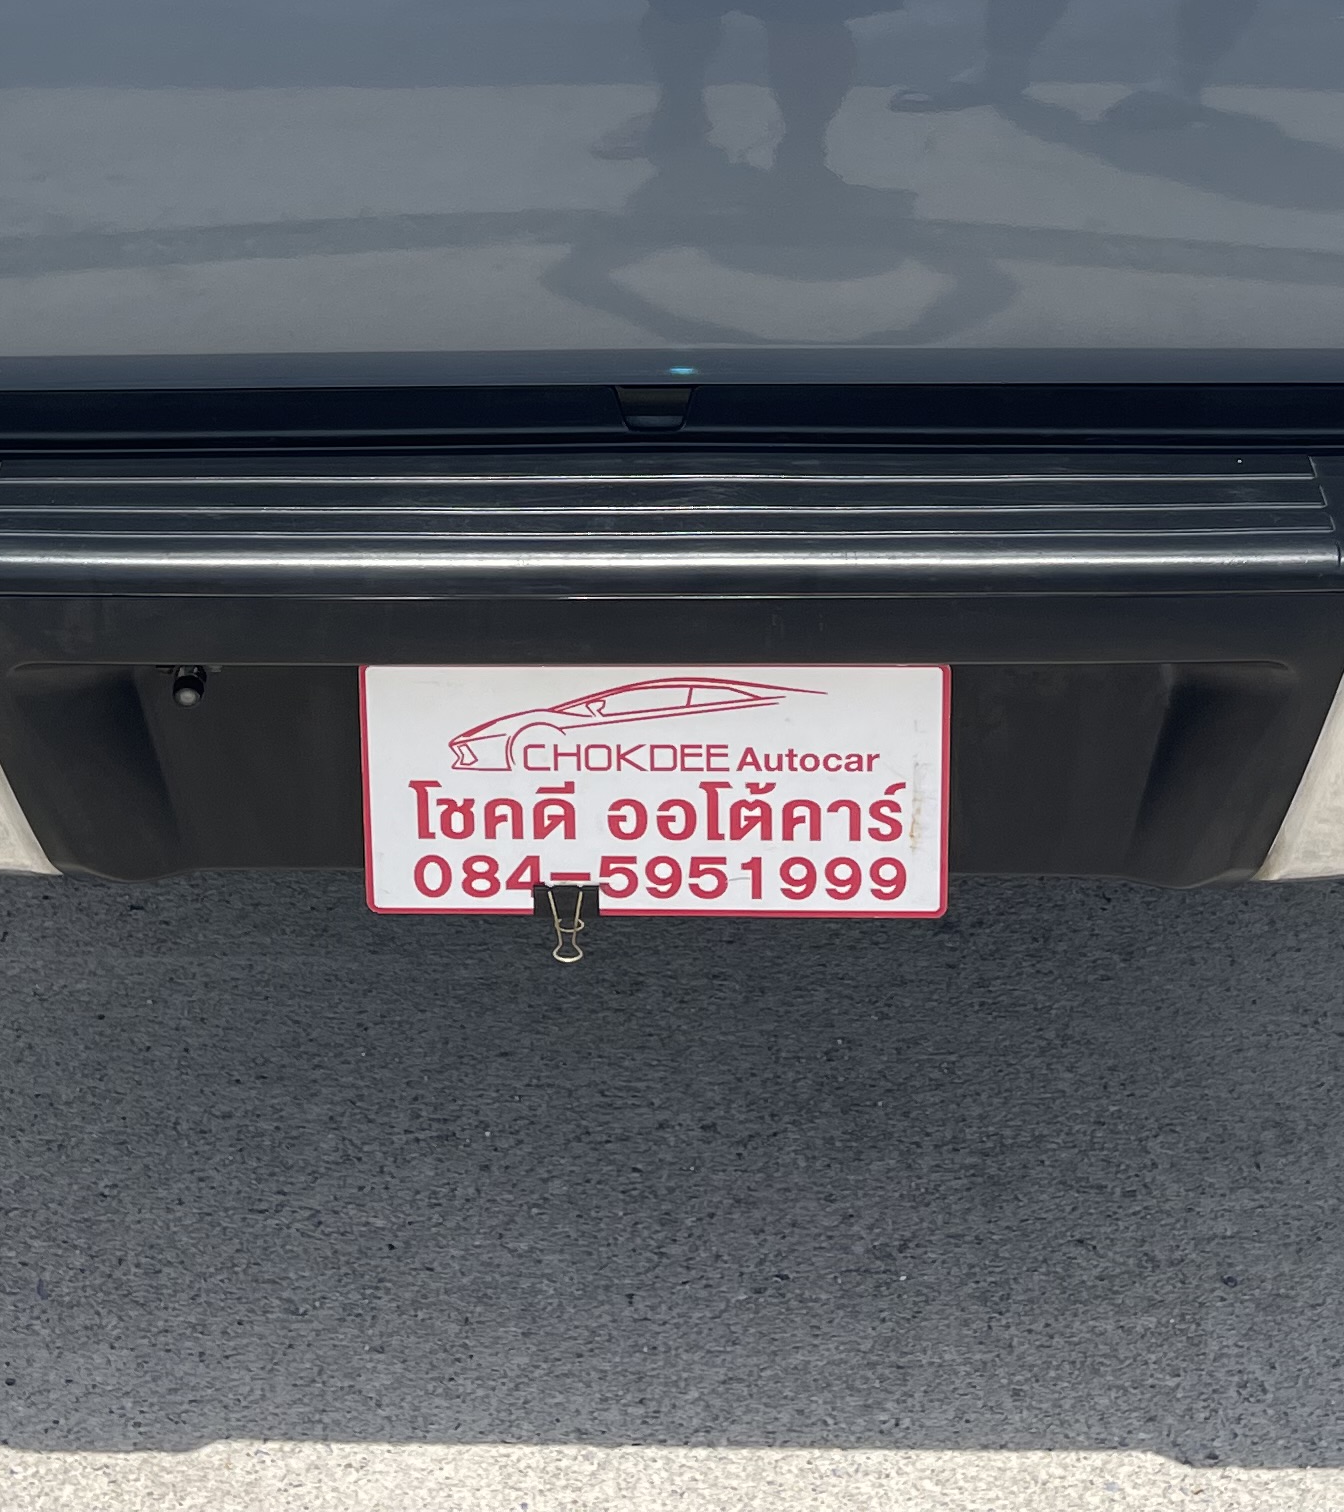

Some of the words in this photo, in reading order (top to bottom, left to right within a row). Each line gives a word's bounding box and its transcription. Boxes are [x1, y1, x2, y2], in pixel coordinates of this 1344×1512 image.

[522, 743, 731, 773] CHOKDEE
[737, 746, 881, 774] Autocar
[408, 779, 578, 842] โชคดี
[606, 780, 907, 843] ออโต้คาร์
[413, 854, 907, 901] 084-5951999
